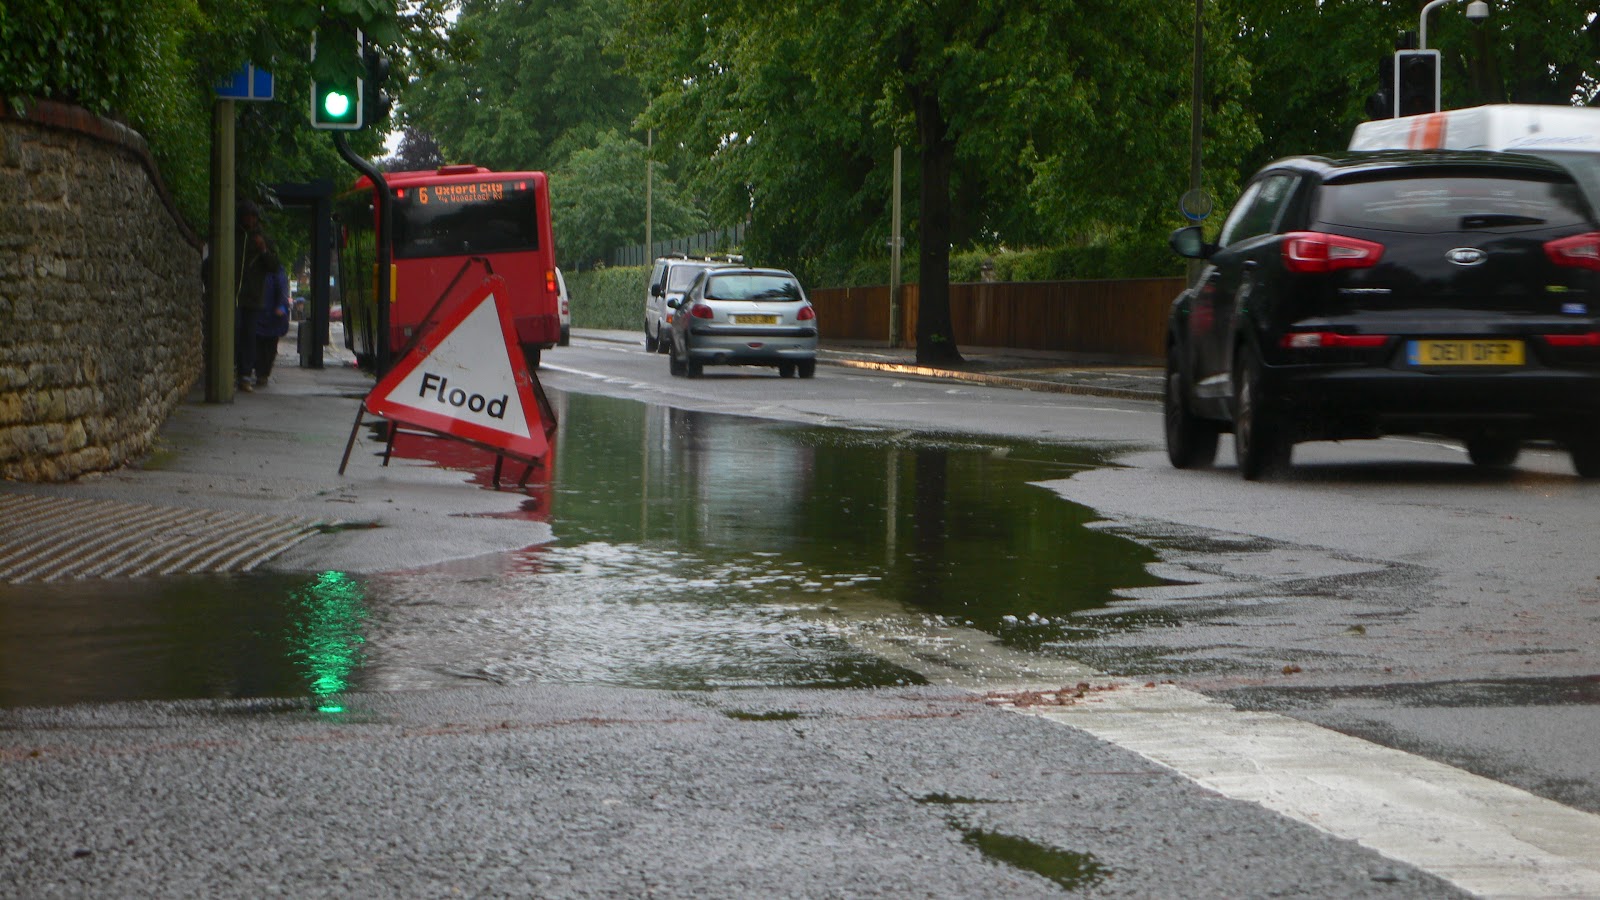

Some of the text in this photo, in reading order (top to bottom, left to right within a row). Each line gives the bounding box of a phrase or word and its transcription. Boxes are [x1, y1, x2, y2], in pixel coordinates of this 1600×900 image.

[419, 187, 428, 204] 6
[435, 183, 503, 195] Oxford City
[419, 372, 509, 420] Flood
